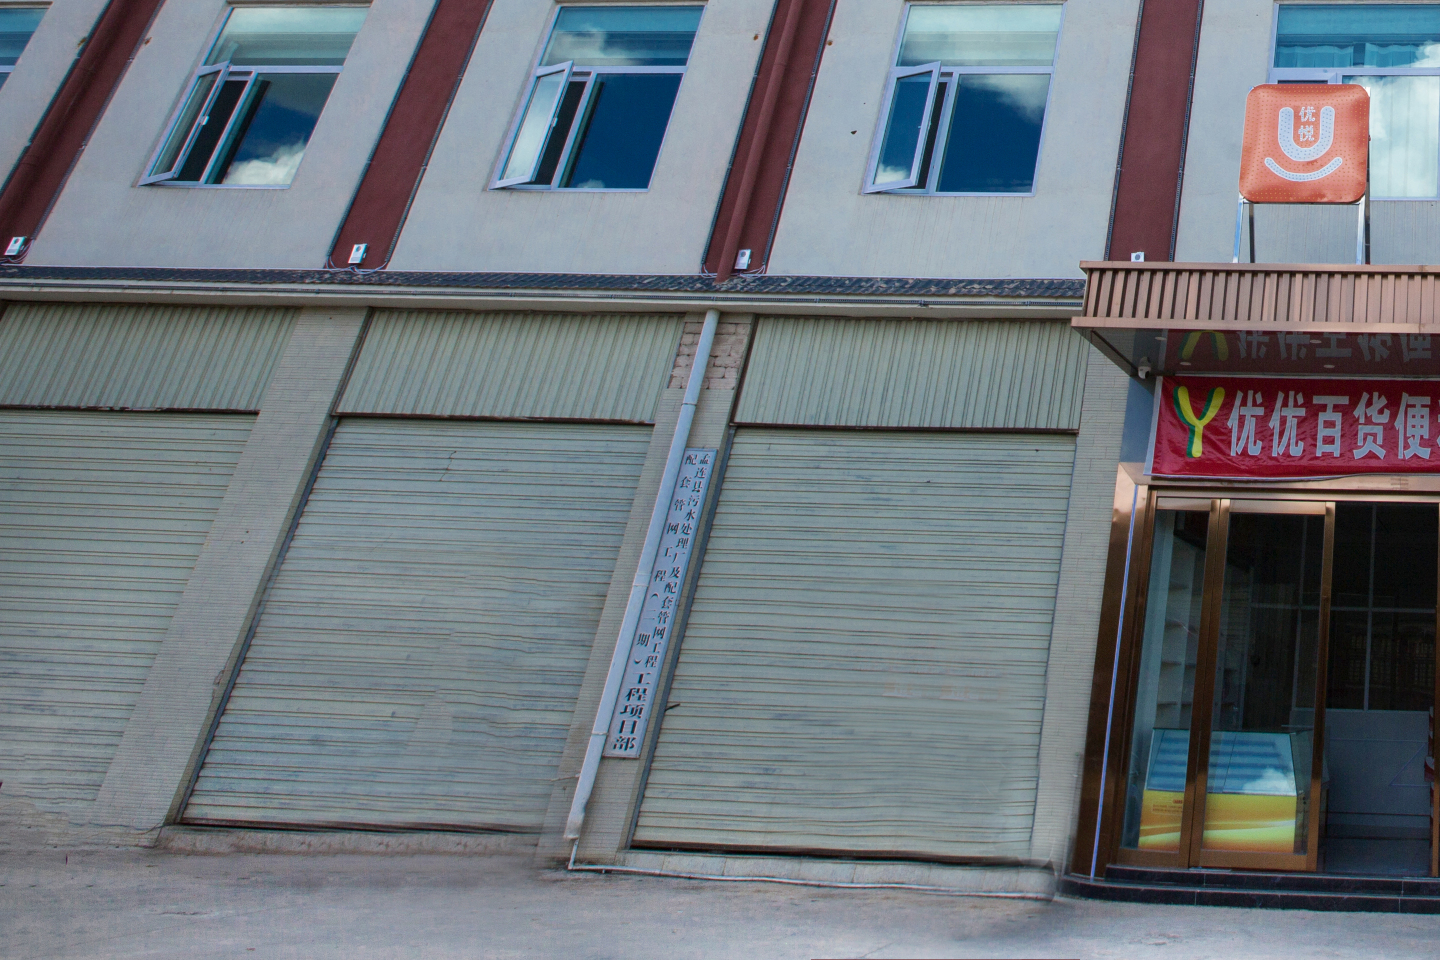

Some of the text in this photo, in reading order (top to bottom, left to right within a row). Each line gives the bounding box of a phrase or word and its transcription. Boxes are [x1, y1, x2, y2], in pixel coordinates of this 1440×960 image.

[1298, 106, 1316, 142] 优悦
[613, 672, 652, 751] 工程项目部
